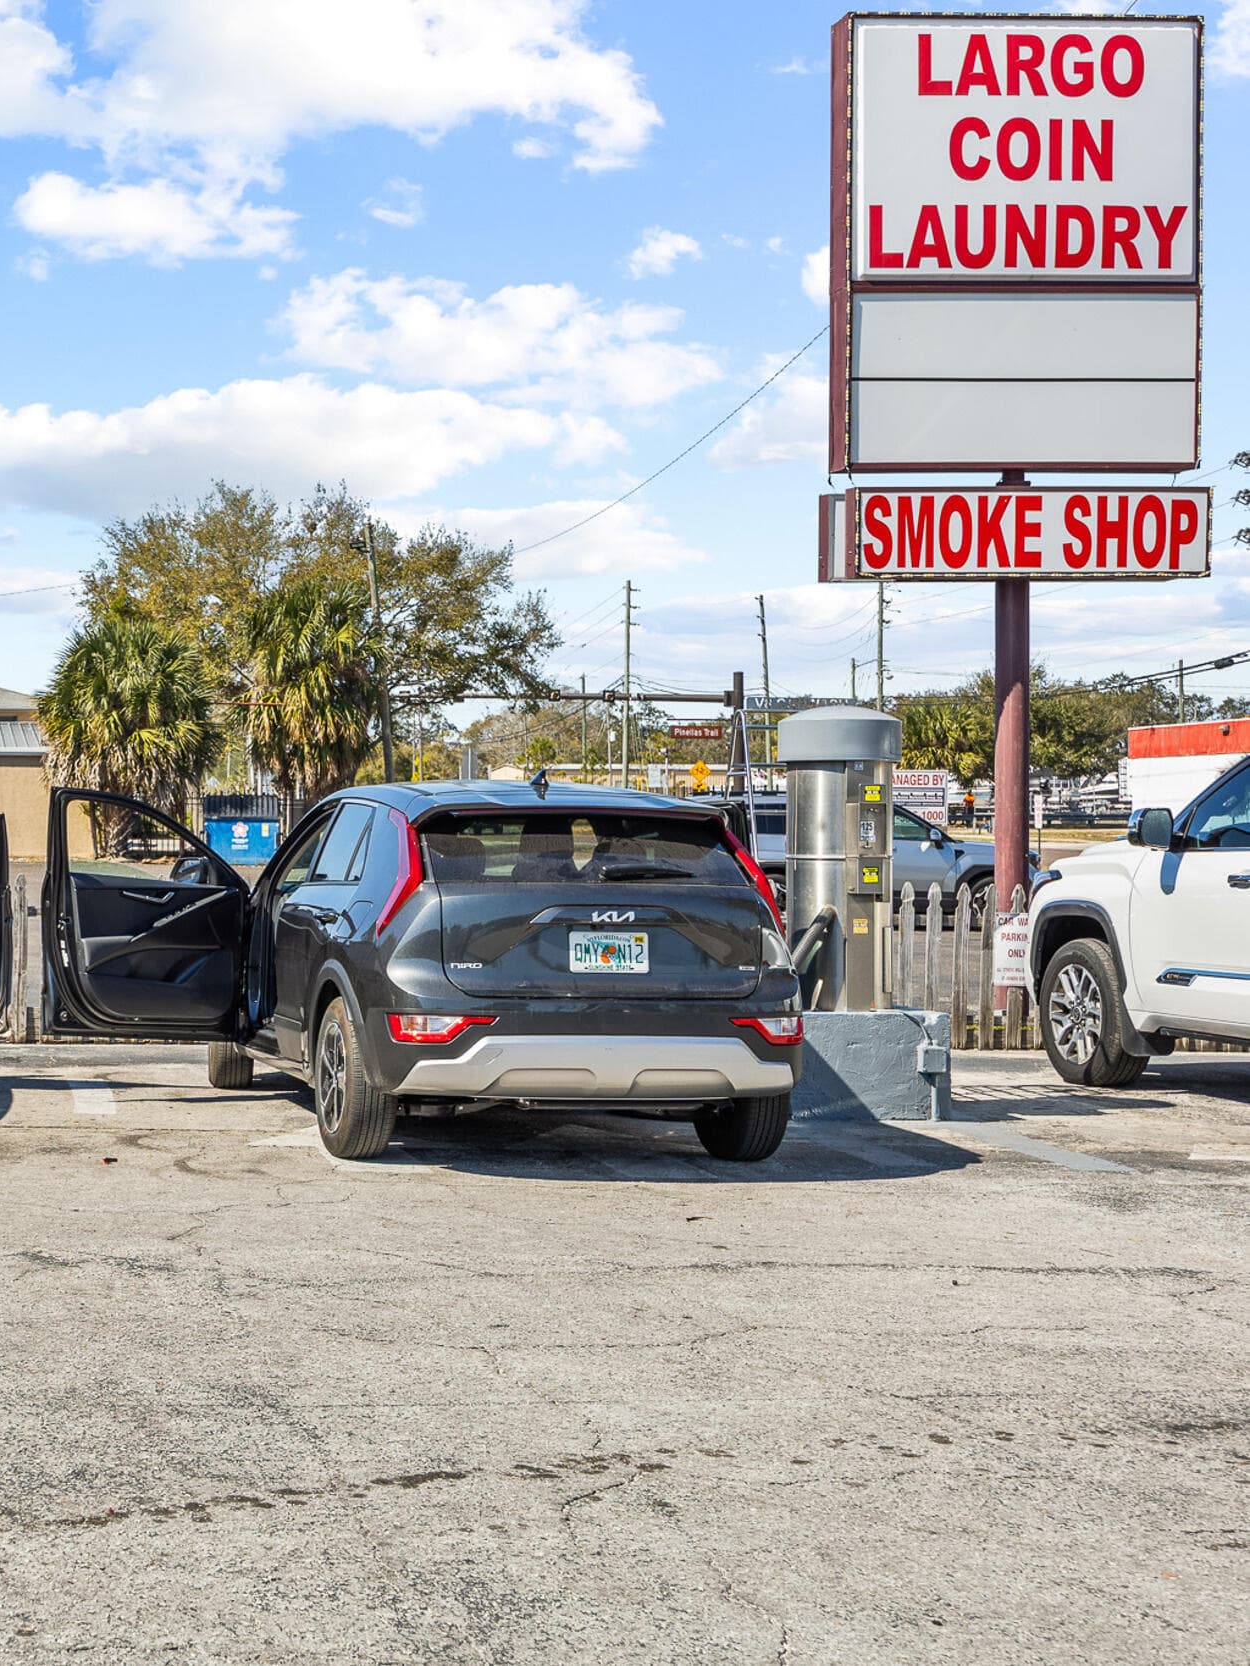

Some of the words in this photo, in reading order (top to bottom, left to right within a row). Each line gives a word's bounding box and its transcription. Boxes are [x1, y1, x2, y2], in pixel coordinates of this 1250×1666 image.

[917, 33, 1145, 98] LARGO
[949, 116, 1115, 182] COIN
[868, 204, 1188, 270] LAUNDRY
[862, 494, 1042, 570] SMOKE
[1062, 494, 1199, 570] SHOP
[674, 728, 703, 737] Pinellas
[704, 728, 719, 737] Trail
[892, 774, 930, 786] ANAGED
[932, 775, 945, 786] BY
[591, 911, 636, 922] KIA
[998, 917, 1014, 926] CAR
[1018, 917, 1029, 926] WA
[1001, 932, 1029, 942] PARKIN
[574, 943, 599, 963] QMY
[618, 944, 644, 964] N12
